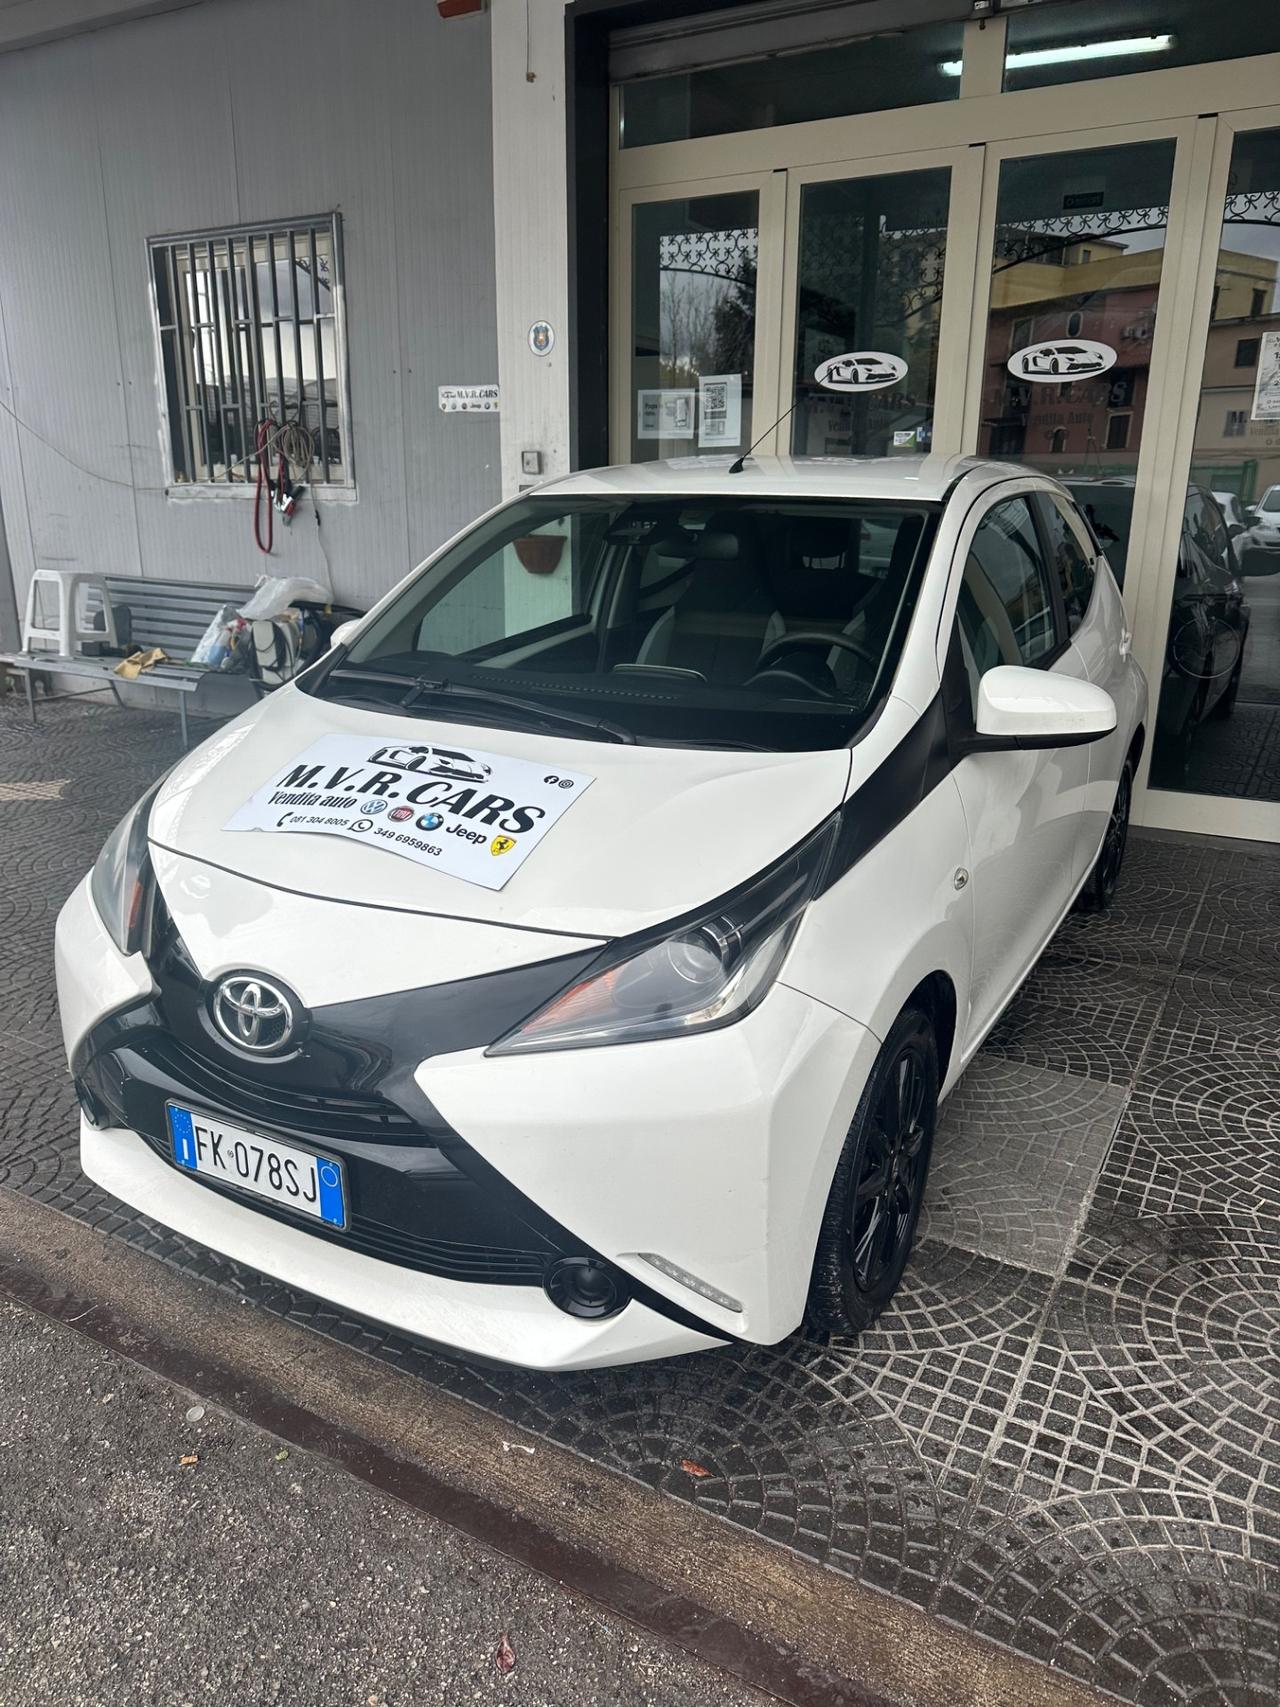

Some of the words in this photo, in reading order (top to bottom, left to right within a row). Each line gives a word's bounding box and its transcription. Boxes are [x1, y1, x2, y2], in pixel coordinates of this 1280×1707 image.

[268, 790, 322, 806] Vendita
[319, 795, 358, 809] auto
[406, 781, 546, 834] CARS
[289, 815, 307, 824] 081
[306, 816, 323, 825] 304
[323, 817, 351, 827] 8005
[373, 827, 396, 839] 349
[395, 834, 443, 857] 6959863
[446, 823, 487, 845] Jeep
